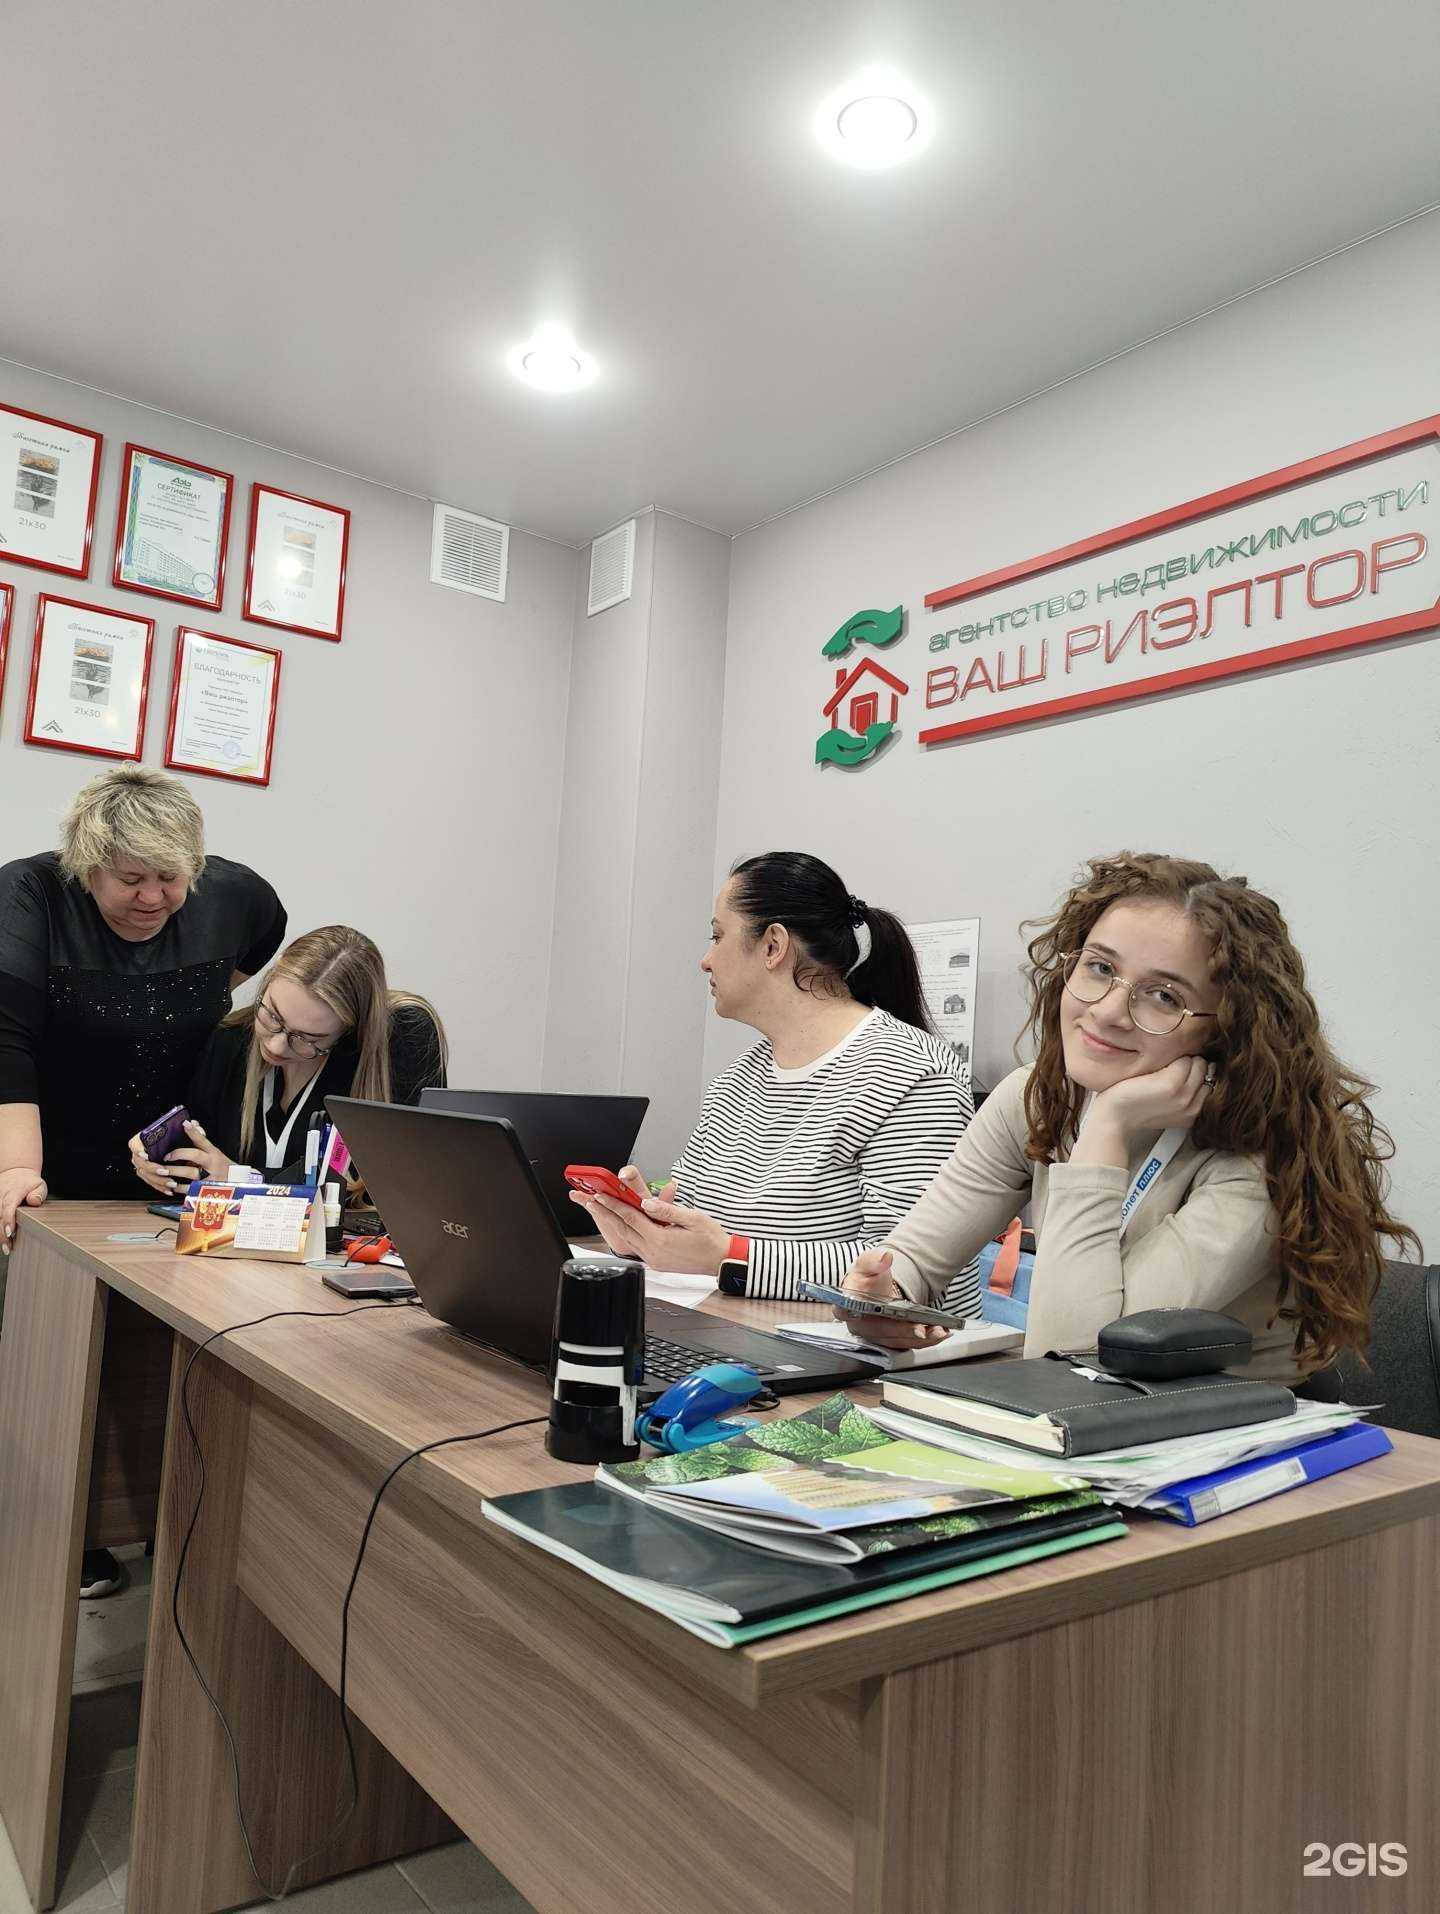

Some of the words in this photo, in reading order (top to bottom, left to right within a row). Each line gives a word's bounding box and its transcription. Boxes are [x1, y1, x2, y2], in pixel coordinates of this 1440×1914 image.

[926, 639, 1048, 709] ВАШ
[1065, 532, 1428, 674] РИЭЛТОР
[194, 662, 262, 684] БЛАГОДАРНОСТЬ
[1138, 1158, 1161, 1190] плюс
[266, 1185, 292, 1196] 2024
[440, 1219, 469, 1239] acer
